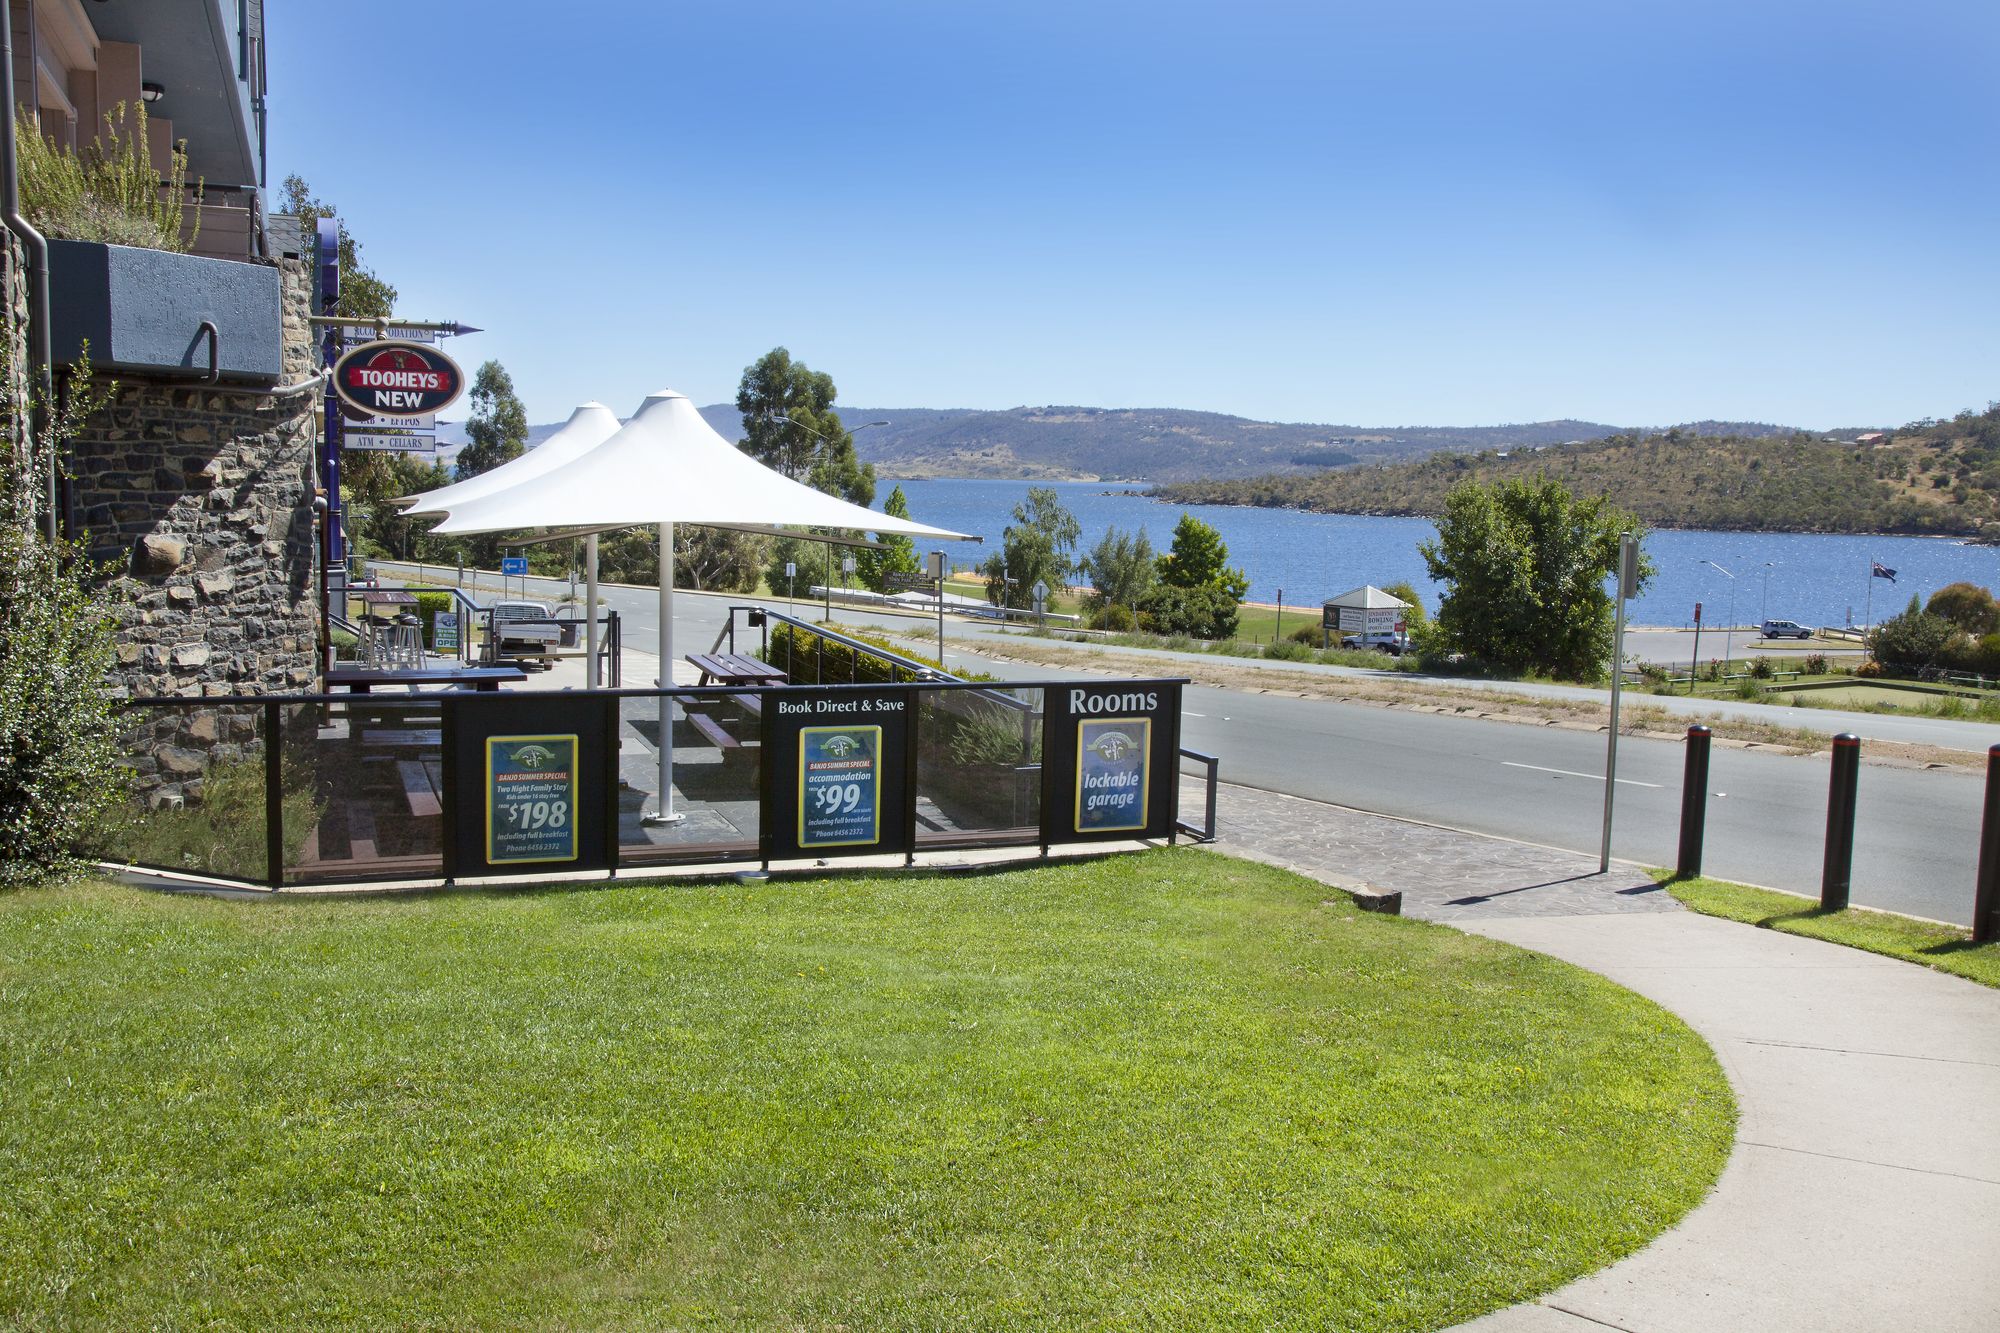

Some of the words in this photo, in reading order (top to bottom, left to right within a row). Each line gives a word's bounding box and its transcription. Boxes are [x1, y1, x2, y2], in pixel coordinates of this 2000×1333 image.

[360, 370, 439, 388] TOOHEYS
[375, 391, 423, 408] NEW
[357, 437, 374, 446] ATM
[389, 438, 422, 448] CELLARS
[779, 700, 812, 714] Book
[816, 700, 857, 713] Direct
[861, 700, 872, 712] &
[875, 699, 904, 711] Save
[1070, 689, 1158, 714] Rooms
[850, 760, 871, 768] SPECIAL
[808, 771, 871, 783] accommodation
[1084, 772, 1139, 788] lockable
[497, 785, 510, 793] Two
[511, 784, 530, 794] Night
[530, 784, 552, 793] Family
[815, 784, 861, 815] $99
[1087, 793, 1134, 811] garage
[508, 801, 567, 829] $198
[808, 818, 834, 826] including
[497, 833, 527, 841] including
[539, 831, 568, 839] breakfast
[816, 830, 834, 838] Phone
[506, 844, 527, 852] Phone
